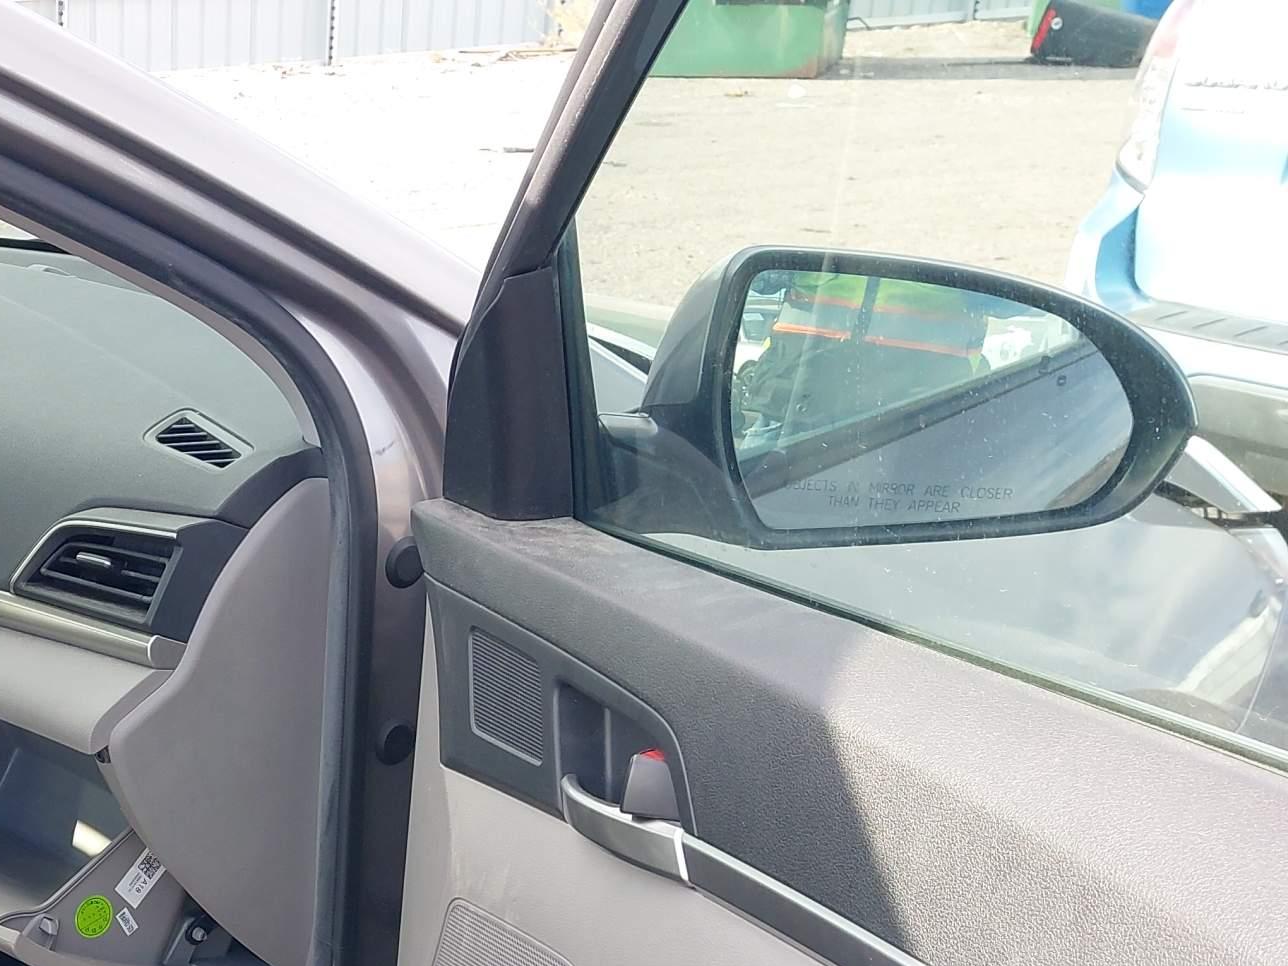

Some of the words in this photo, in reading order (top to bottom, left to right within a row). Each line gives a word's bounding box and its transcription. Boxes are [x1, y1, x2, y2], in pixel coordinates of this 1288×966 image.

[869, 483, 915, 497] MIRROR
[924, 485, 951, 498] ARE
[960, 487, 1014, 500] CLOSER
[828, 495, 860, 507] THAN
[869, 498, 901, 511] THEY
[908, 500, 961, 513] APPEAR
